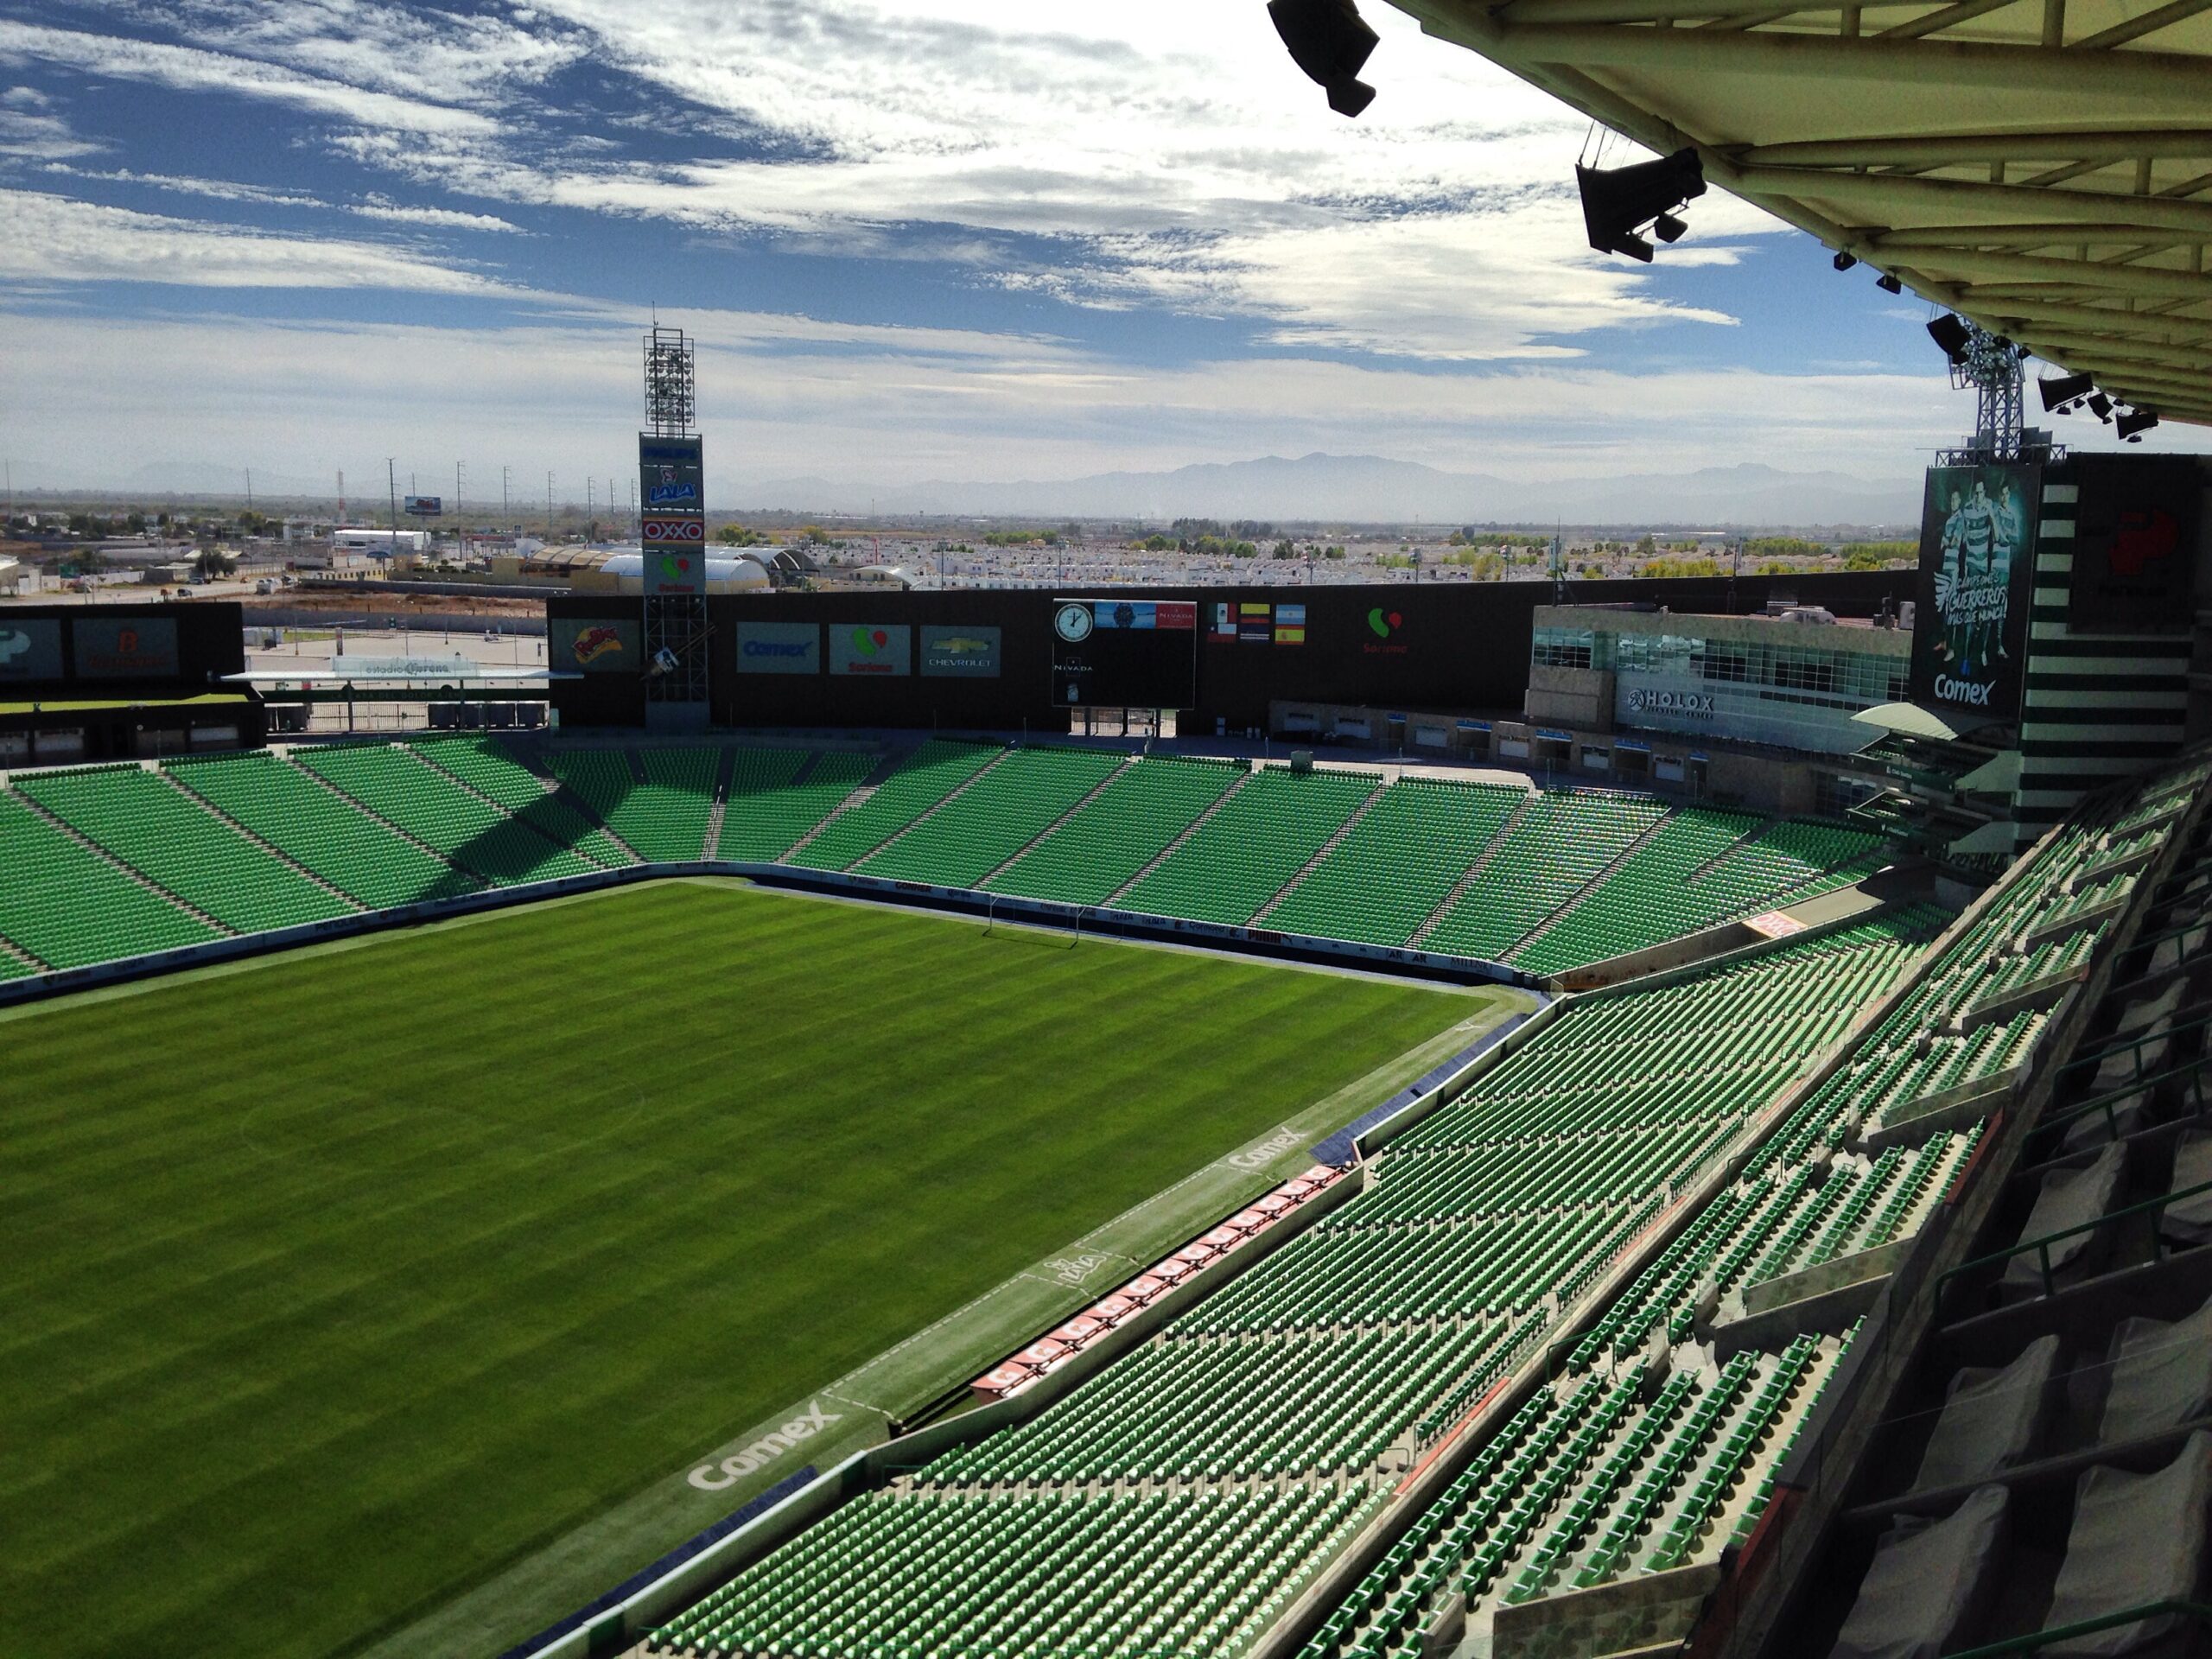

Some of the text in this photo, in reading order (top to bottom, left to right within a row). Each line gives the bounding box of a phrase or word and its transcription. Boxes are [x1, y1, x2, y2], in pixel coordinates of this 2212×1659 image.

[650, 483, 696, 504] LALA
[645, 522, 702, 540] OXXO
[743, 640, 814, 658] Comex
[928, 658, 990, 668] CHEVROLET
[1935, 673, 1997, 705] Comex
[1646, 690, 1713, 712] HOLOX
[1229, 1126, 1310, 1167] Comex
[688, 1399, 843, 1491] Comex
